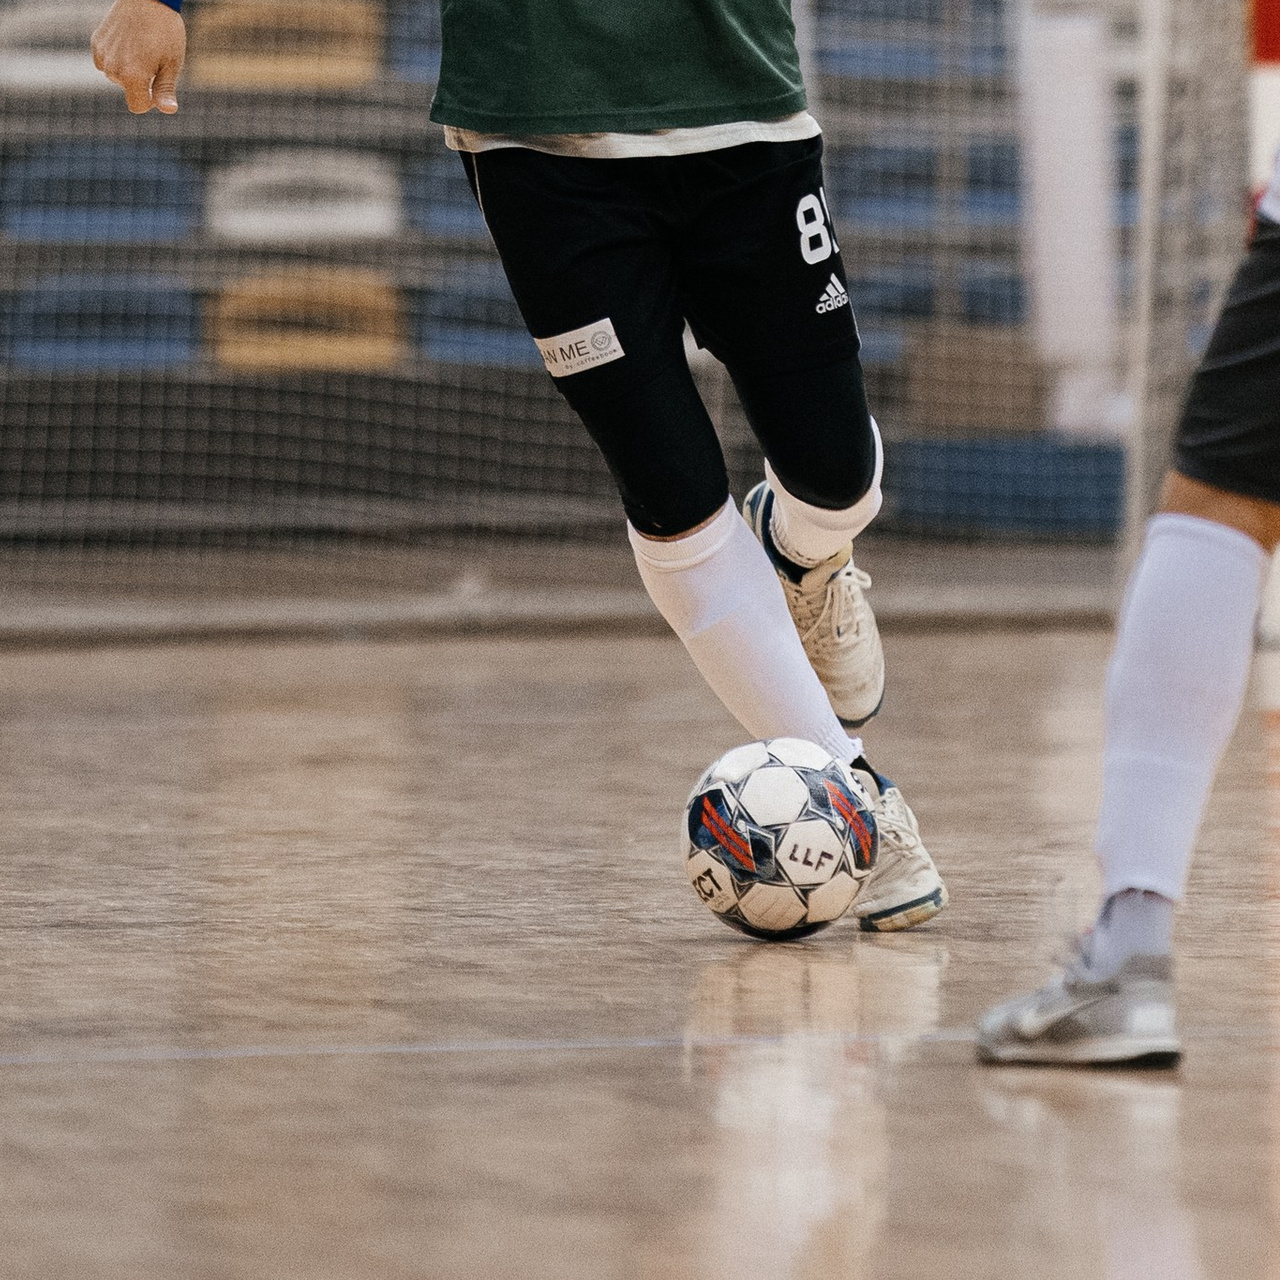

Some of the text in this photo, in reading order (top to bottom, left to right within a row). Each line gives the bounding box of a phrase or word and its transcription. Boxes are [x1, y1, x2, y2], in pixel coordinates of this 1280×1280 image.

[796, 185, 840, 265] 8
[559, 339, 590, 362] ME
[789, 843, 834, 872] LLF
